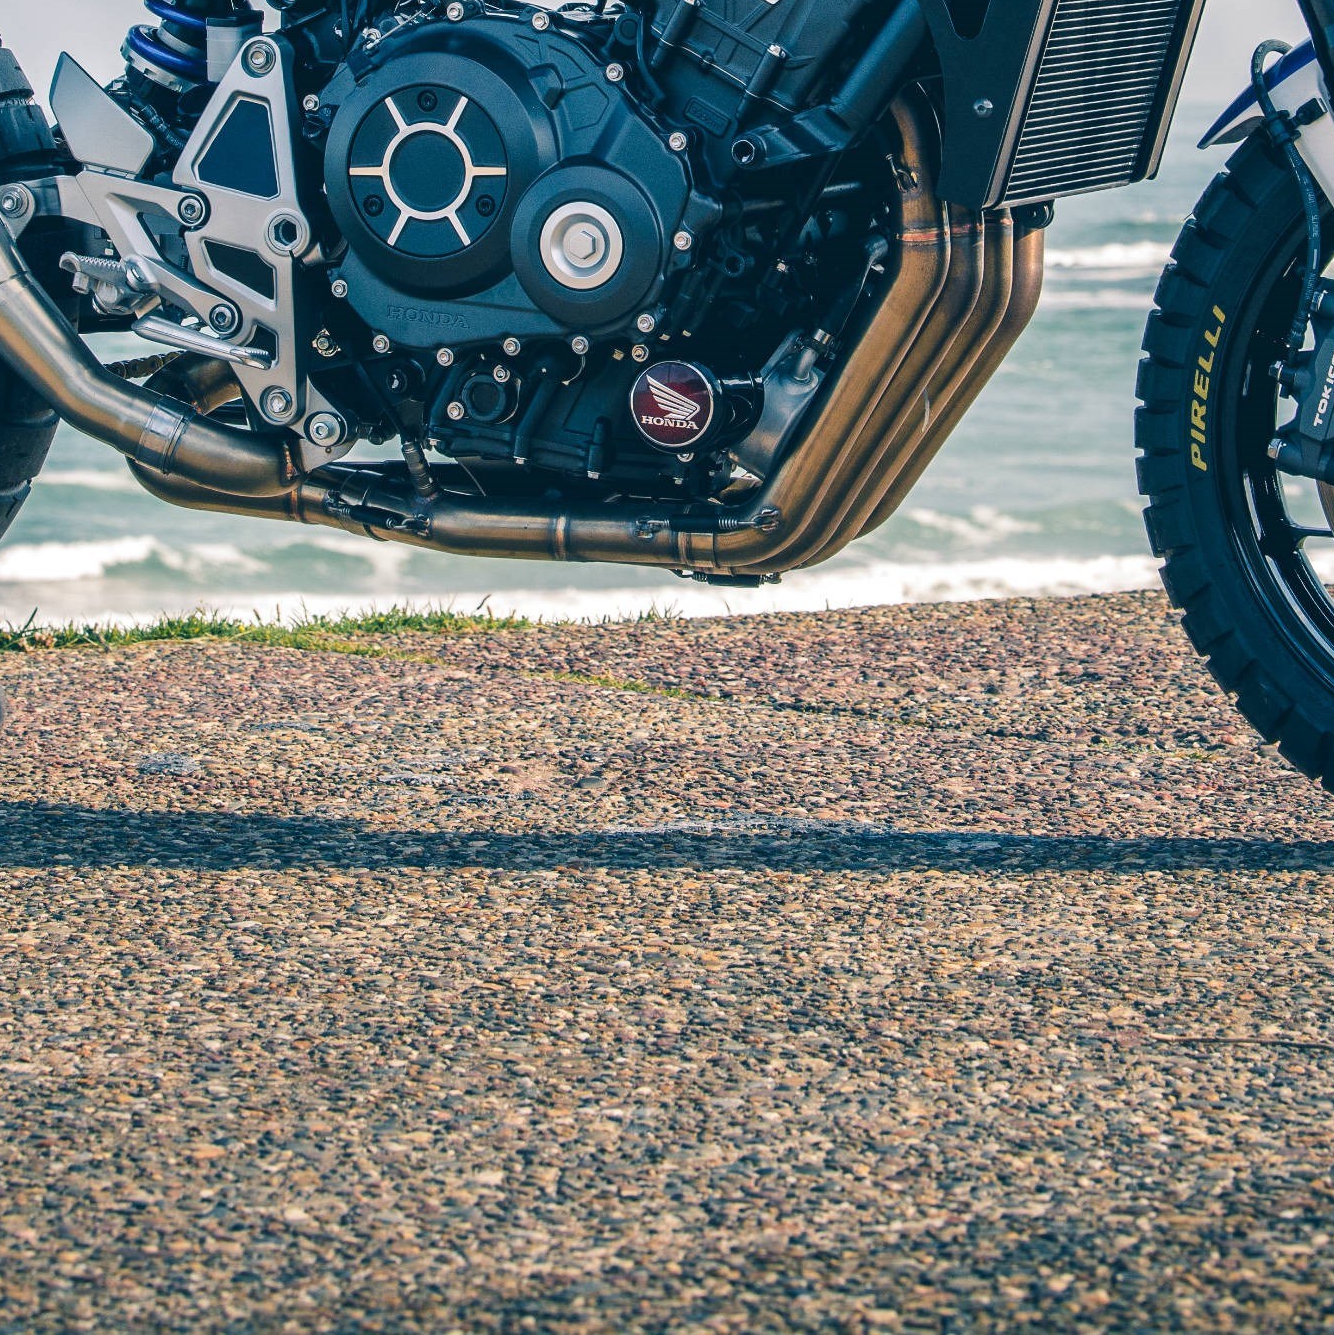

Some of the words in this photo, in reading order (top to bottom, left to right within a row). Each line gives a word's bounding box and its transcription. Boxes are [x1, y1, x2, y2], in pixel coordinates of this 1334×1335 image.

[387, 305, 471, 329] HONDA
[1190, 304, 1226, 472] PIRELLI
[641, 415, 699, 430] HONDA
